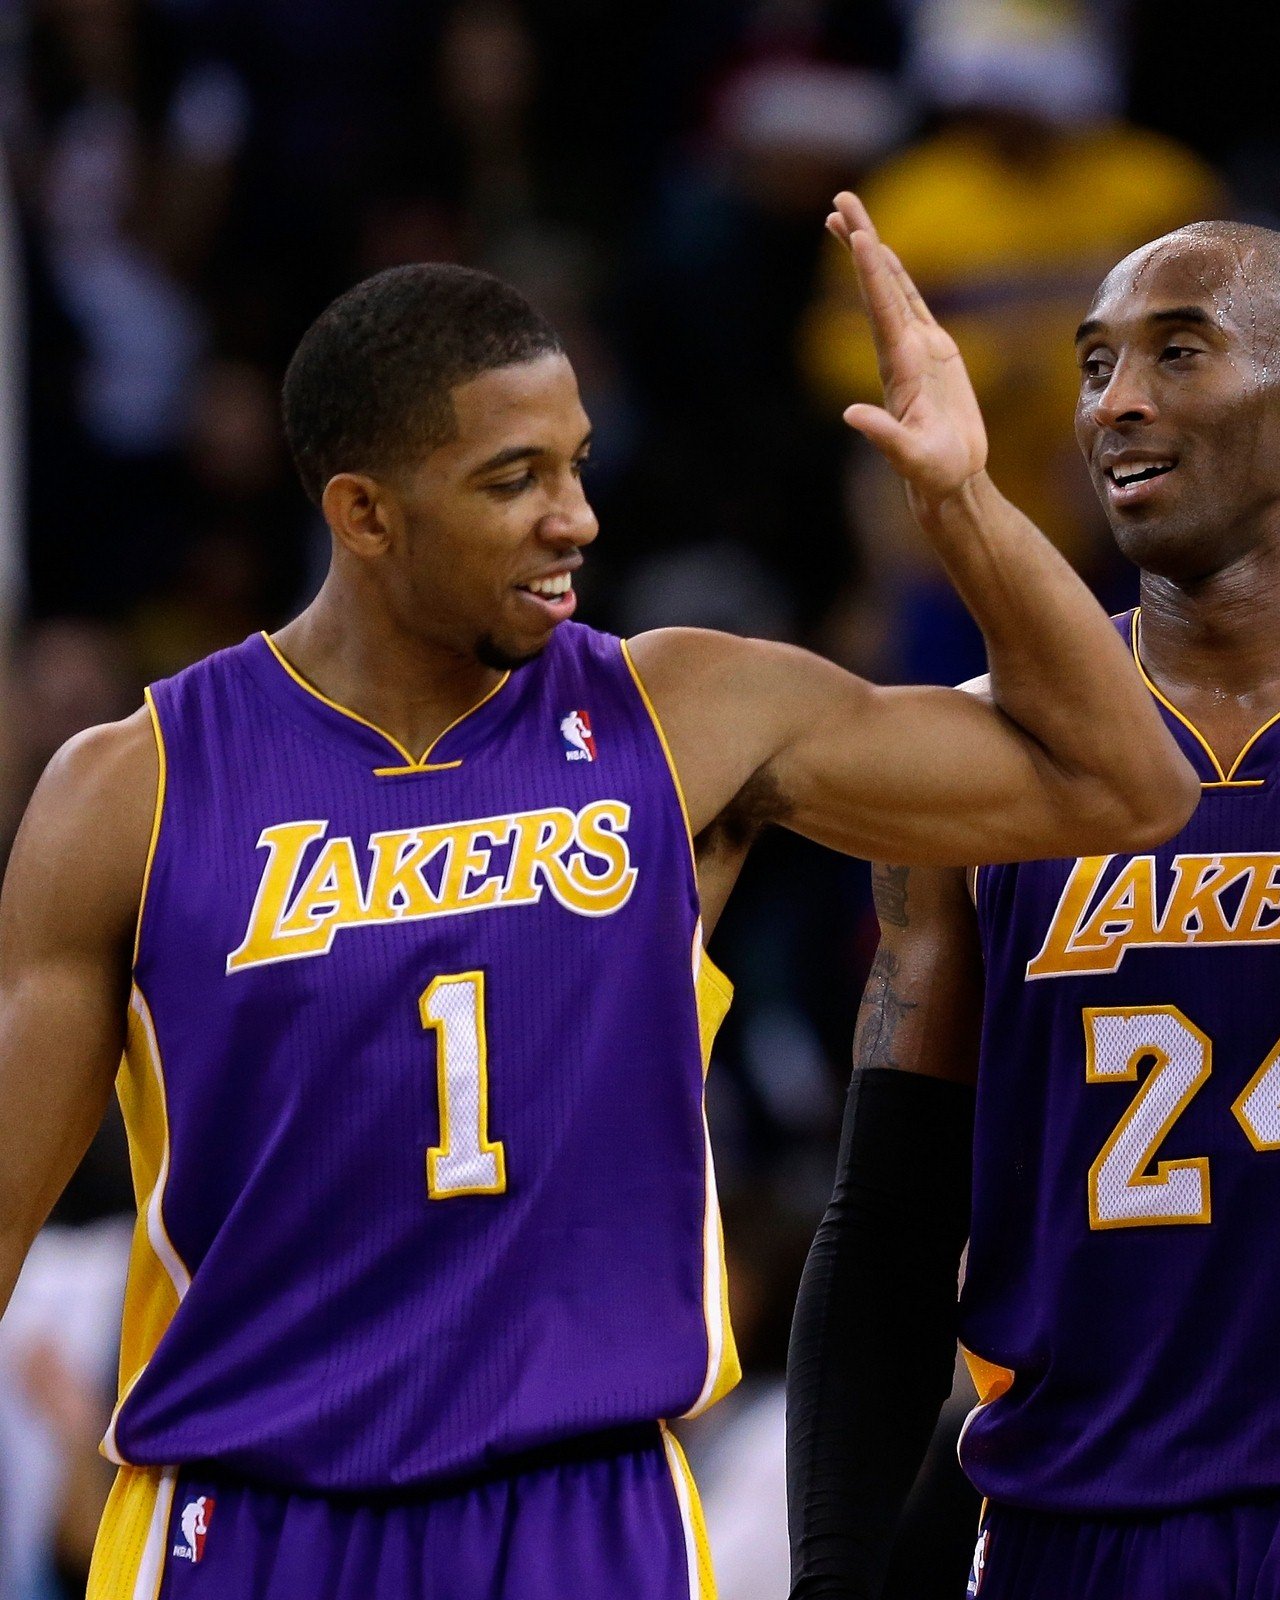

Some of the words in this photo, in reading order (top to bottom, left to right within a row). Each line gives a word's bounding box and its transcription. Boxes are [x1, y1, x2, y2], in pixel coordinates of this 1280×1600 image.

[226, 799, 637, 974] LAKERS
[419, 970, 506, 1199] 1
[173, 1545, 192, 1559] NBA
